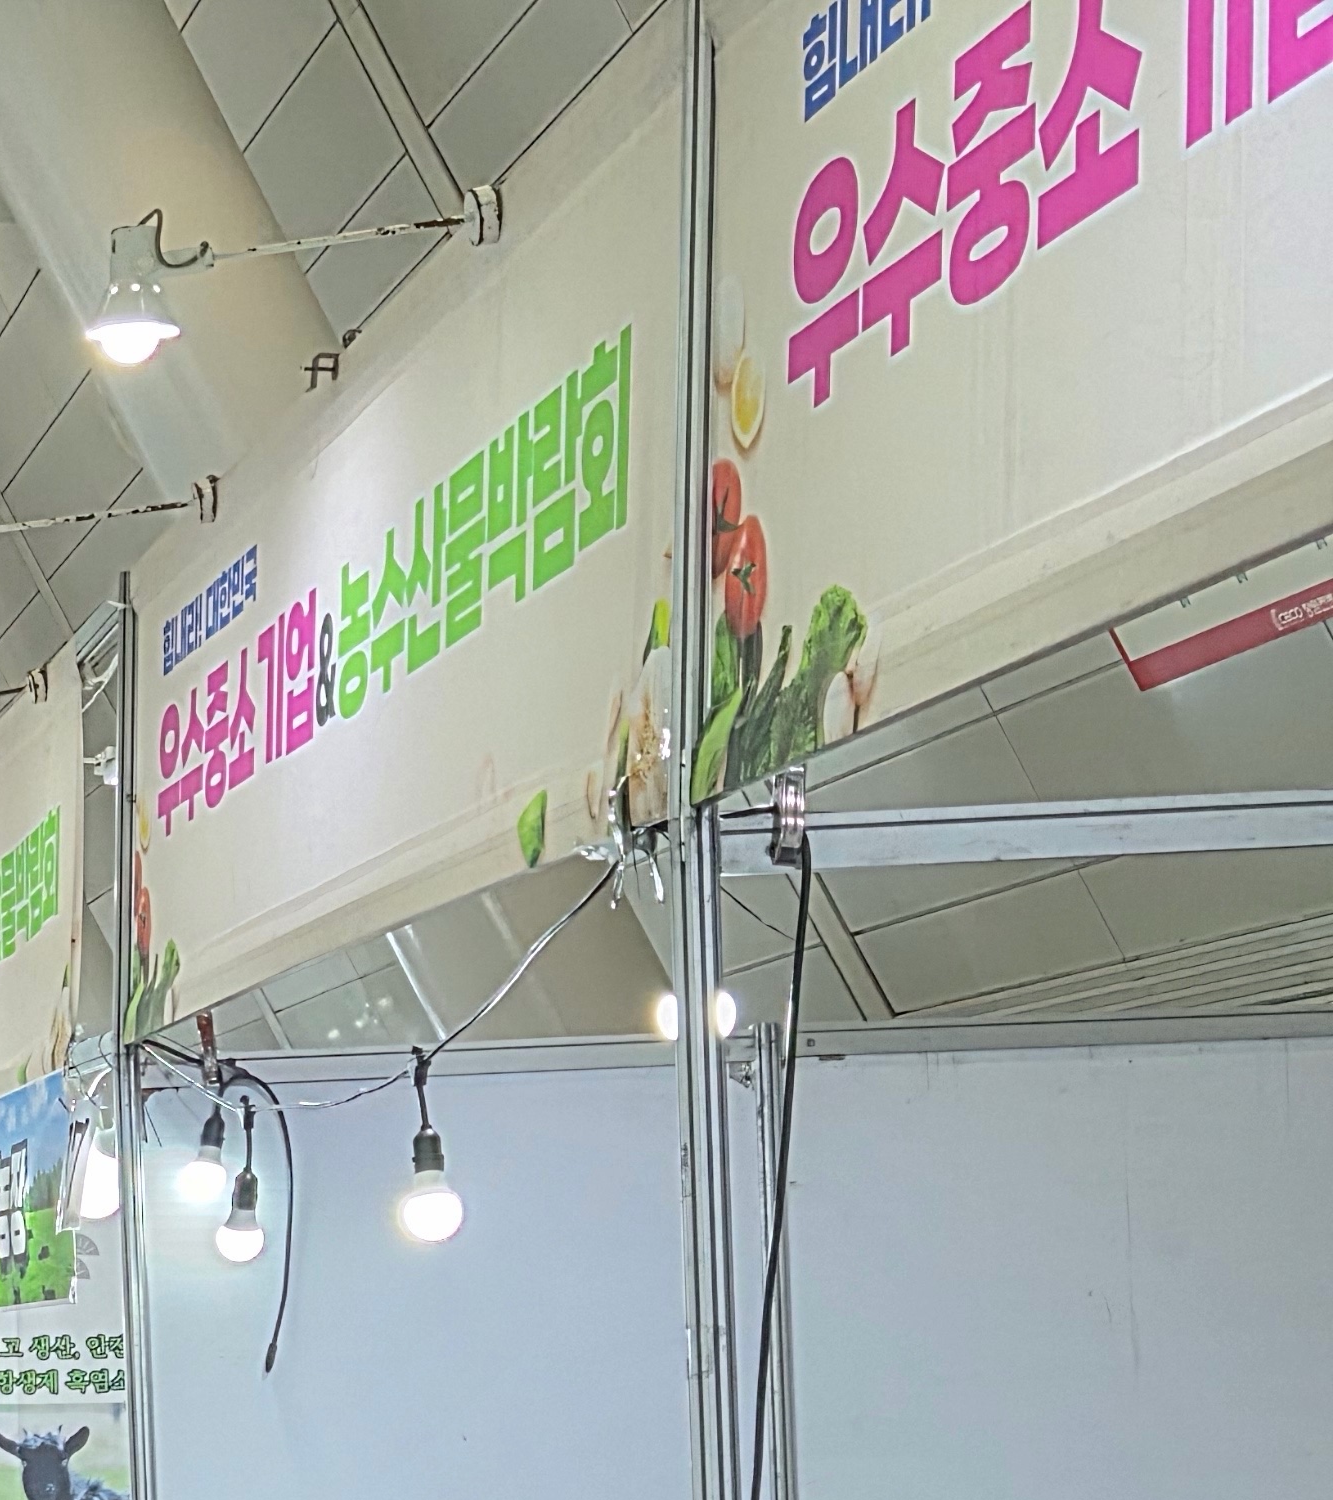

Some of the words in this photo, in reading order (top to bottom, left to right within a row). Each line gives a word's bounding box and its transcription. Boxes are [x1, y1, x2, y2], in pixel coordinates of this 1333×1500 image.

[803, 0, 930, 123] 힘내
[163, 594, 202, 676] 힘내라!
[205, 544, 258, 642] 대한민국
[29, 1334, 81, 1361] 생산,
